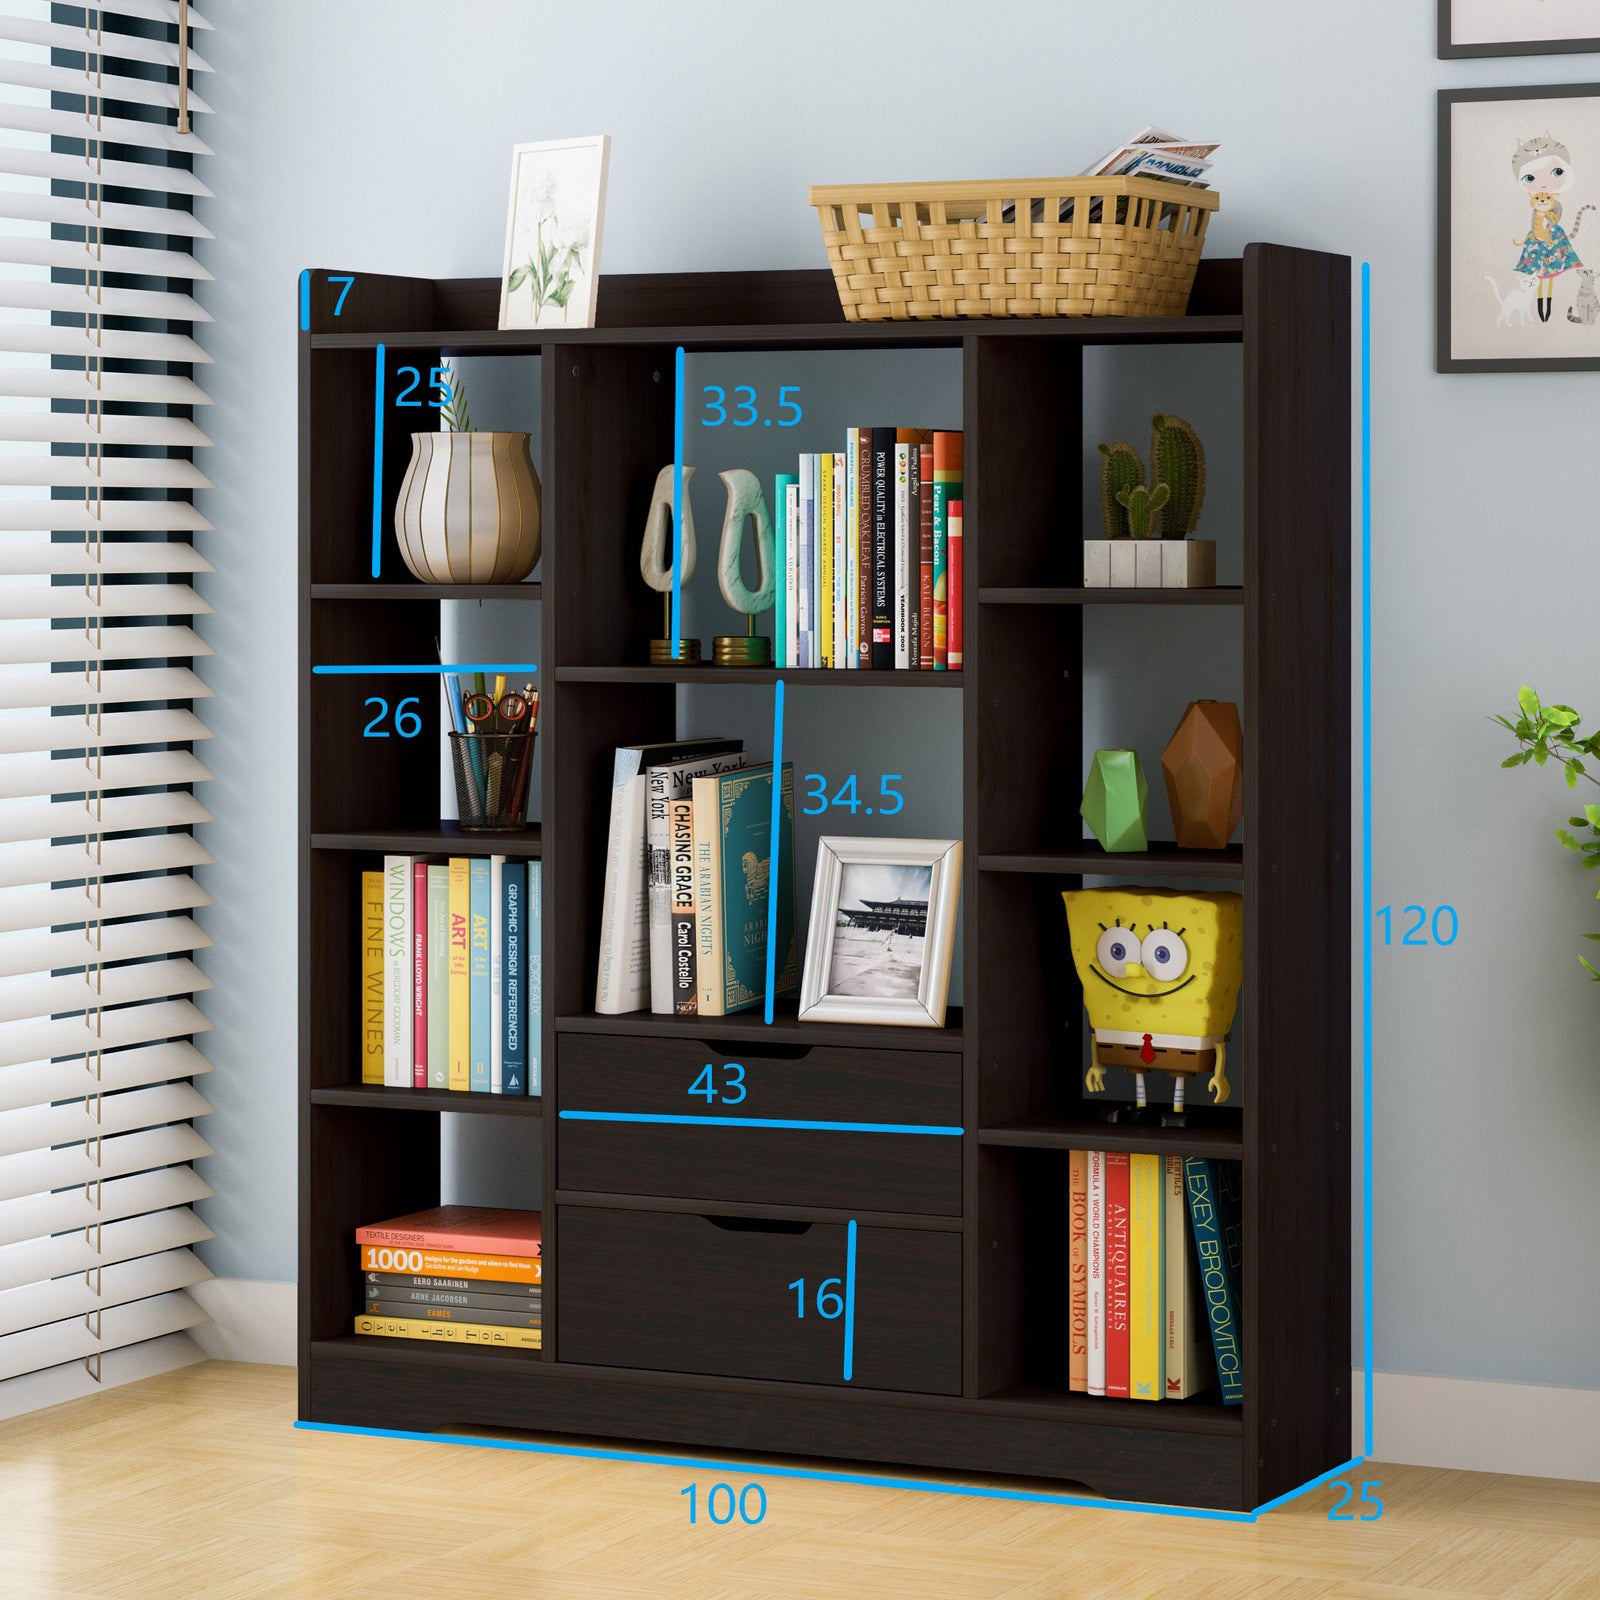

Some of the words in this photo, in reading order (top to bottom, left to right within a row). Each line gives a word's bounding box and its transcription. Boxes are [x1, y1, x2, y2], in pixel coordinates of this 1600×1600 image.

[861, 449, 871, 511] CRUMBLED
[876, 452, 886, 478] POWER
[875, 480, 886, 513] QUALITY
[933, 485, 942, 513] Pear
[861, 513, 871, 539] OAK
[934, 516, 942, 526] &
[861, 541, 871, 569] LEAF
[876, 522, 886, 570] ELECTRICAL
[933, 530, 942, 565] Bacon
[860, 575, 868, 604] Patricia
[876, 571, 886, 607] SYSTEMS
[923, 574, 931, 602] KATE
[860, 606, 869, 636] Gavros
[923, 607, 931, 648] BEATON
[651, 770, 670, 795] New
[673, 768, 707, 789] New
[651, 796, 670, 820] York
[674, 804, 691, 864] CHASING
[699, 841, 711, 862] THE
[675, 866, 692, 907] GRACE
[700, 865, 712, 912] ARABIAN
[389, 864, 406, 957] WINDOWS
[508, 883, 518, 933] GRAPHIC
[367, 902, 384, 957] FINE
[415, 934, 424, 959] FRANK
[452, 913, 467, 950] ART
[473, 914, 489, 951] ART
[677, 922, 692, 947] Carol
[701, 916, 713, 956] NIGHTS
[415, 960, 424, 984] LLOYD
[508, 935, 518, 976] DESIGN
[678, 949, 693, 988] Costello
[393, 967, 402, 1004] BERGDORF
[415, 986, 424, 1016] WRIGHT
[529, 954, 541, 1016] BORDEAUX
[366, 970, 384, 1056] WINES
[393, 1005, 402, 1045] GOODMAN
[508, 978, 518, 1051] REFERENCED
[1072, 1168, 1080, 1186] THE
[1092, 1151, 1100, 1191] FORMULA
[1072, 1191, 1087, 1243] BOOK
[1092, 1199, 1100, 1229] WORLD
[366, 1231, 389, 1241] TEXTILE
[391, 1232, 425, 1243] DESIGNERS
[1092, 1230, 1101, 1279] CHAMPIONS
[367, 1247, 424, 1272] 1000
[1112, 1203, 1127, 1331] ANTIQUAIRES
[411, 1292, 430, 1302] ARNE
[433, 1294, 468, 1304] JACOBSEN
[413, 1276, 430, 1286] EERO
[433, 1278, 469, 1289] SAARINEN
[427, 1309, 452, 1319] EAMES
[1072, 1263, 1087, 1355] SYMBOLS
[1200, 1240, 1242, 1387] BRODOVITCH
[361, 1321, 407, 1333] Over
[421, 1326, 459, 1338] the
[467, 1330, 506, 1343] Top
